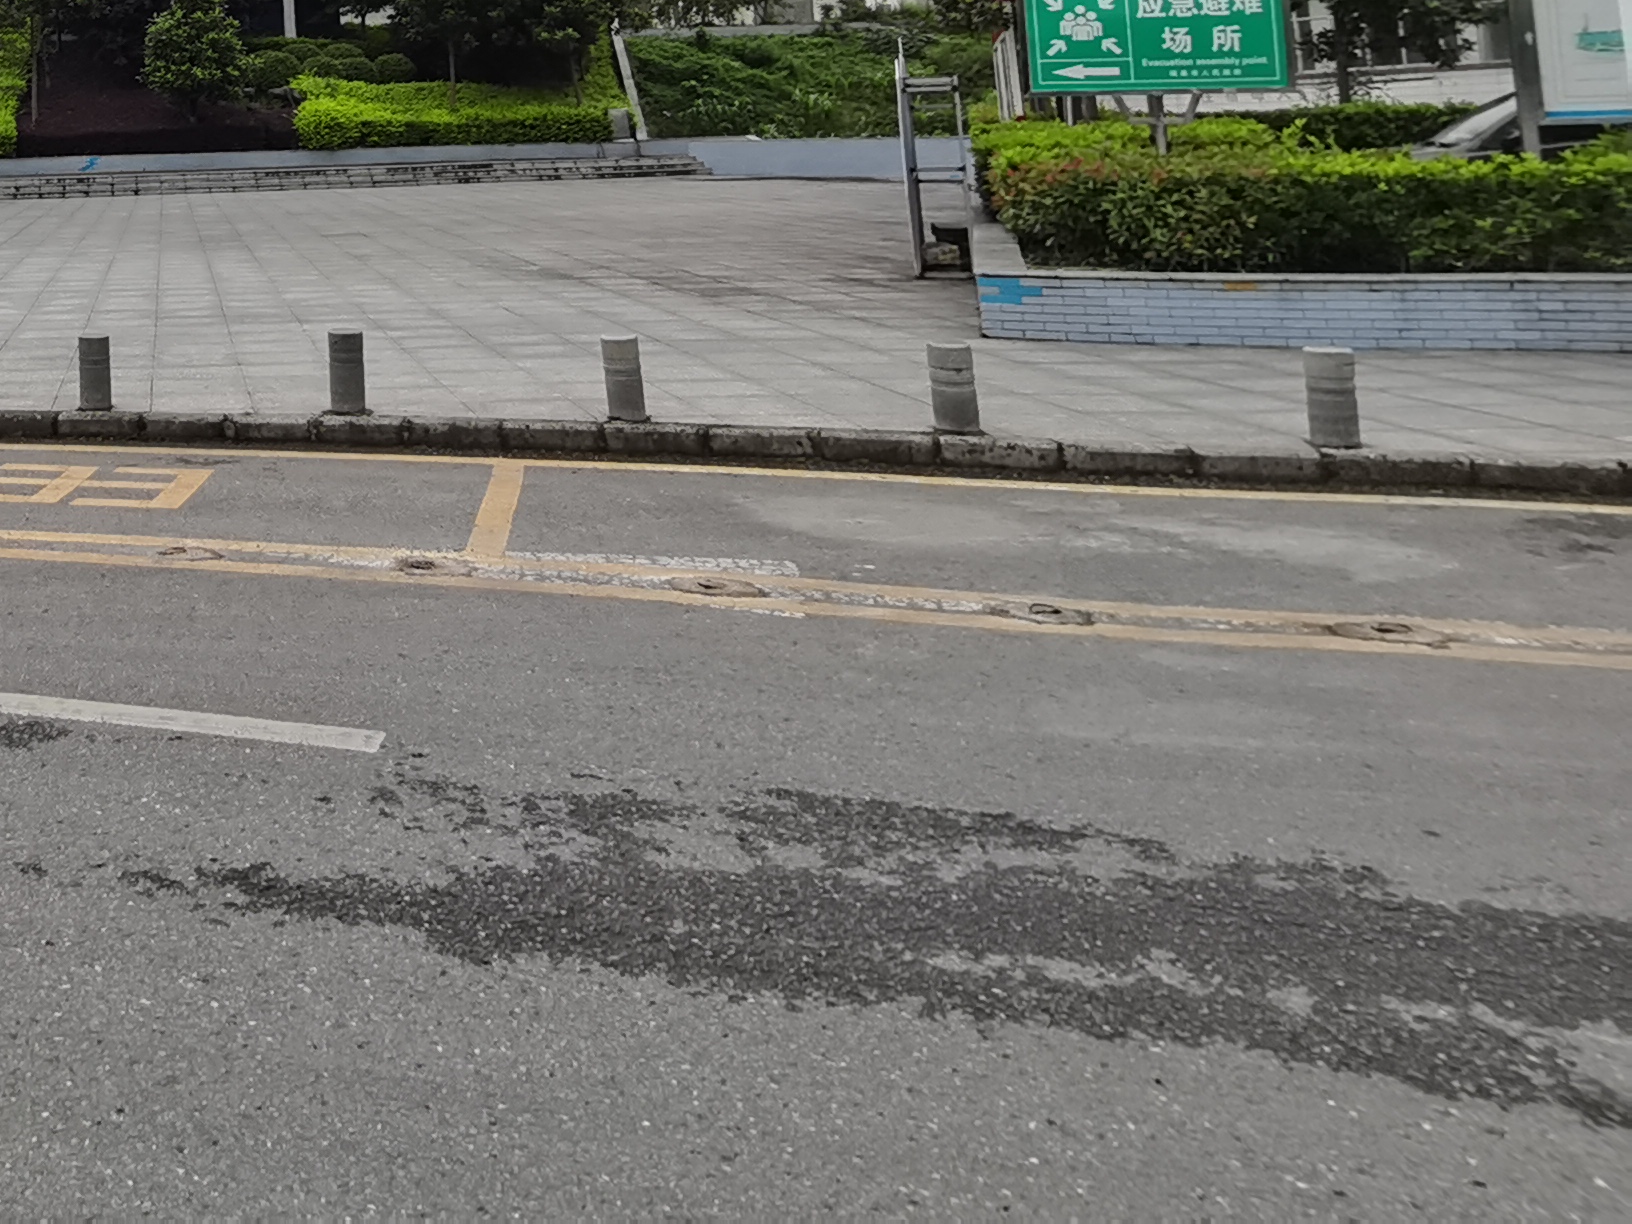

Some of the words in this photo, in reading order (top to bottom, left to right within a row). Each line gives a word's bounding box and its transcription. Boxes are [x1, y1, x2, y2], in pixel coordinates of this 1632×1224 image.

[1161, 25, 1242, 53] 场所
[1142, 57, 1194, 67] Evacuation
[1196, 57, 1240, 66] assembly
[1241, 55, 1268, 66] point
